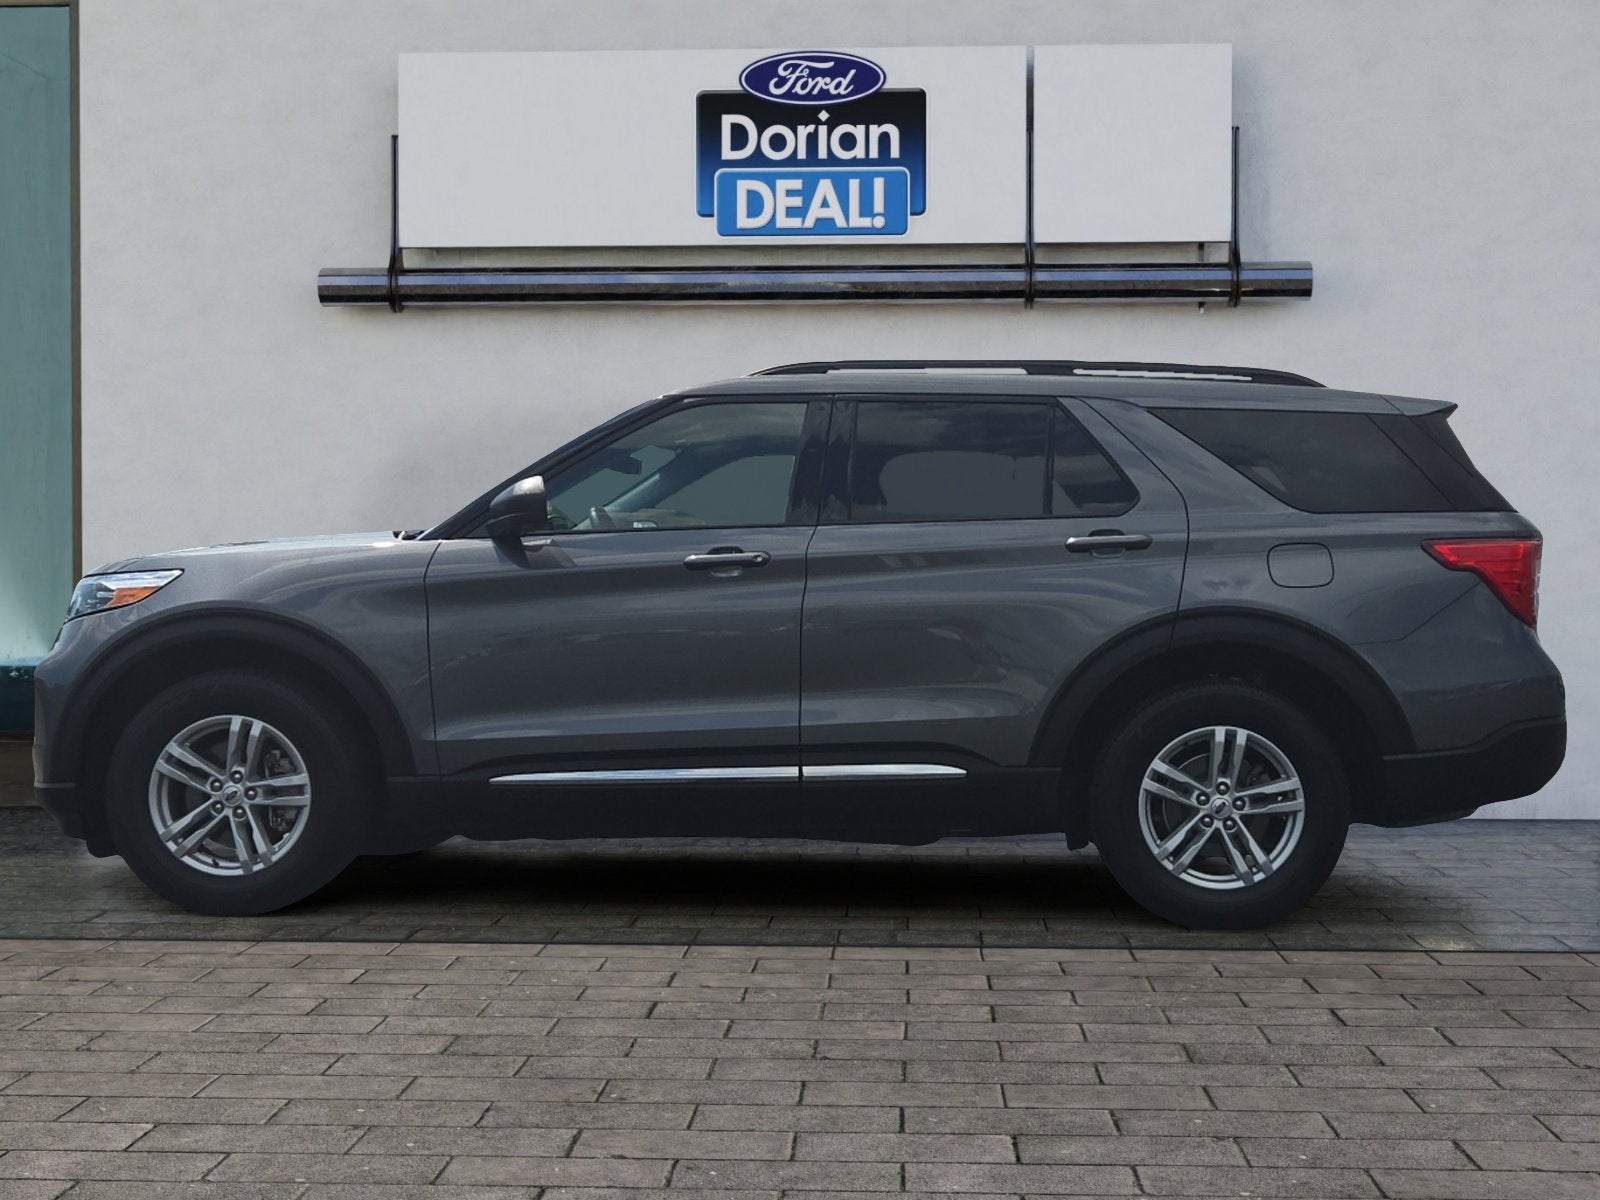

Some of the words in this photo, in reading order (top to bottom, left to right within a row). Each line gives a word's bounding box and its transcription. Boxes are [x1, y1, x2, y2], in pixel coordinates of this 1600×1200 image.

[768, 60, 856, 95] Ford
[721, 110, 900, 160] Dorian
[736, 177, 886, 229] DEAL!
